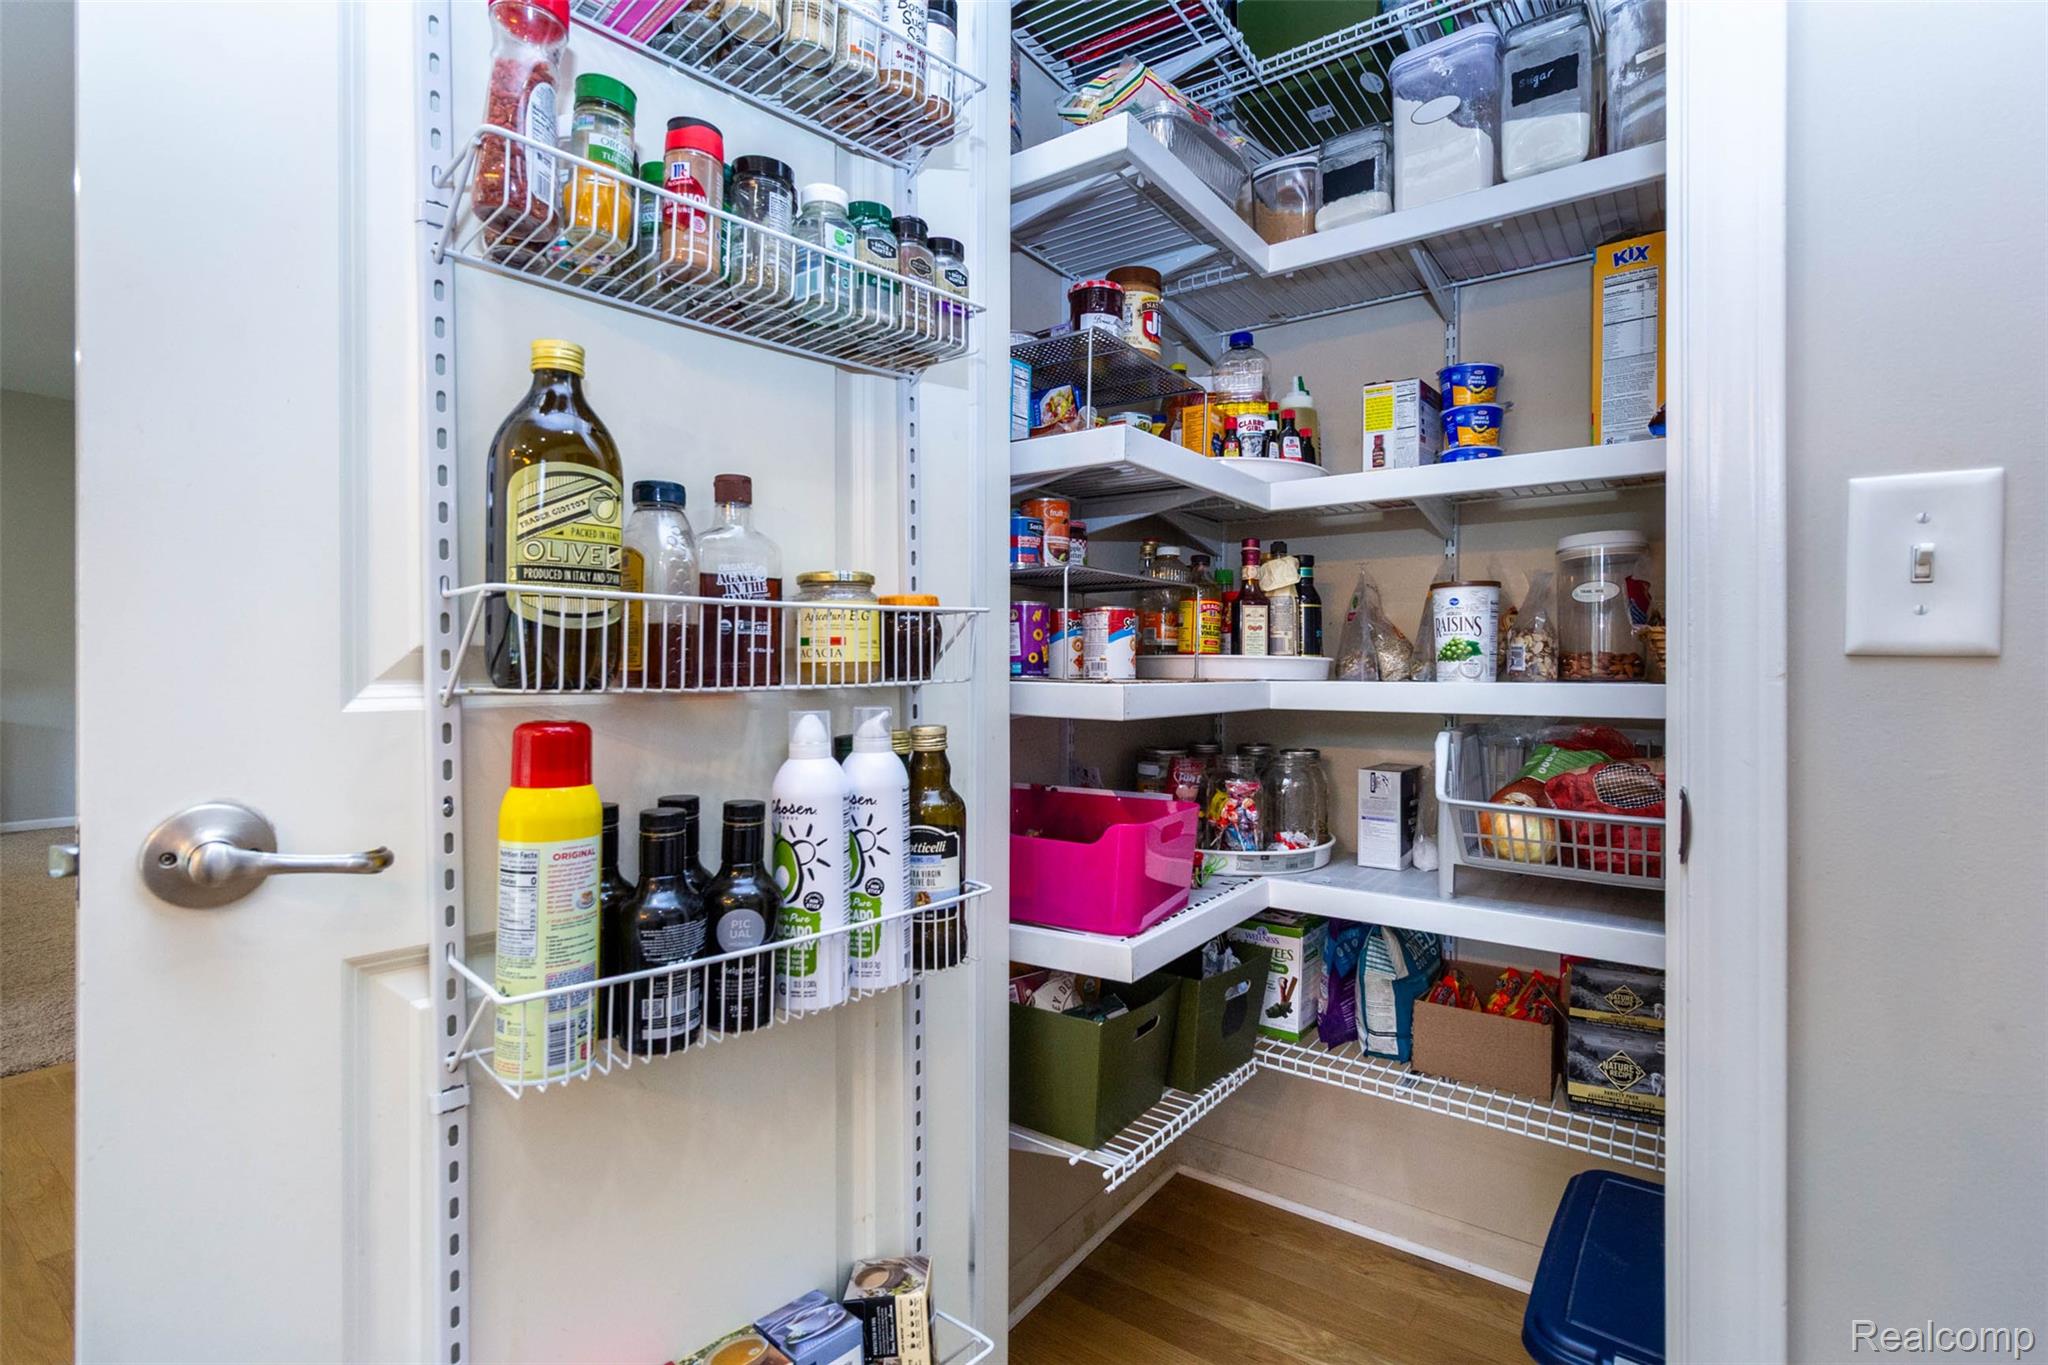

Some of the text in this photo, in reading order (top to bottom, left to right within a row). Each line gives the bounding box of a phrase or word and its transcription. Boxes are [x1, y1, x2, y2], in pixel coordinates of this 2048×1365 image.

[519, 499, 587, 529] TRADER GIOTTO'S
[571, 527, 598, 539] PACKED
[599, 530, 606, 539] IN
[523, 540, 604, 566] OLIVE
[523, 568, 563, 580] PRODUCED
[564, 570, 572, 581] IN
[573, 570, 592, 582] ITALY
[592, 572, 606, 583] AND
[716, 572, 758, 586] AGAVE
[727, 580, 768, 595] IN THE
[1435, 616, 1482, 638] RAISINS
[921, 869, 941, 878] VIRGIN
[731, 920, 751, 929] PIC
[729, 929, 753, 939] UAL
[1244, 932, 1280, 944] WELLNESS
[1602, 1060, 1641, 1075] NATURE'S
[1609, 1070, 1634, 1079] RECIPE
